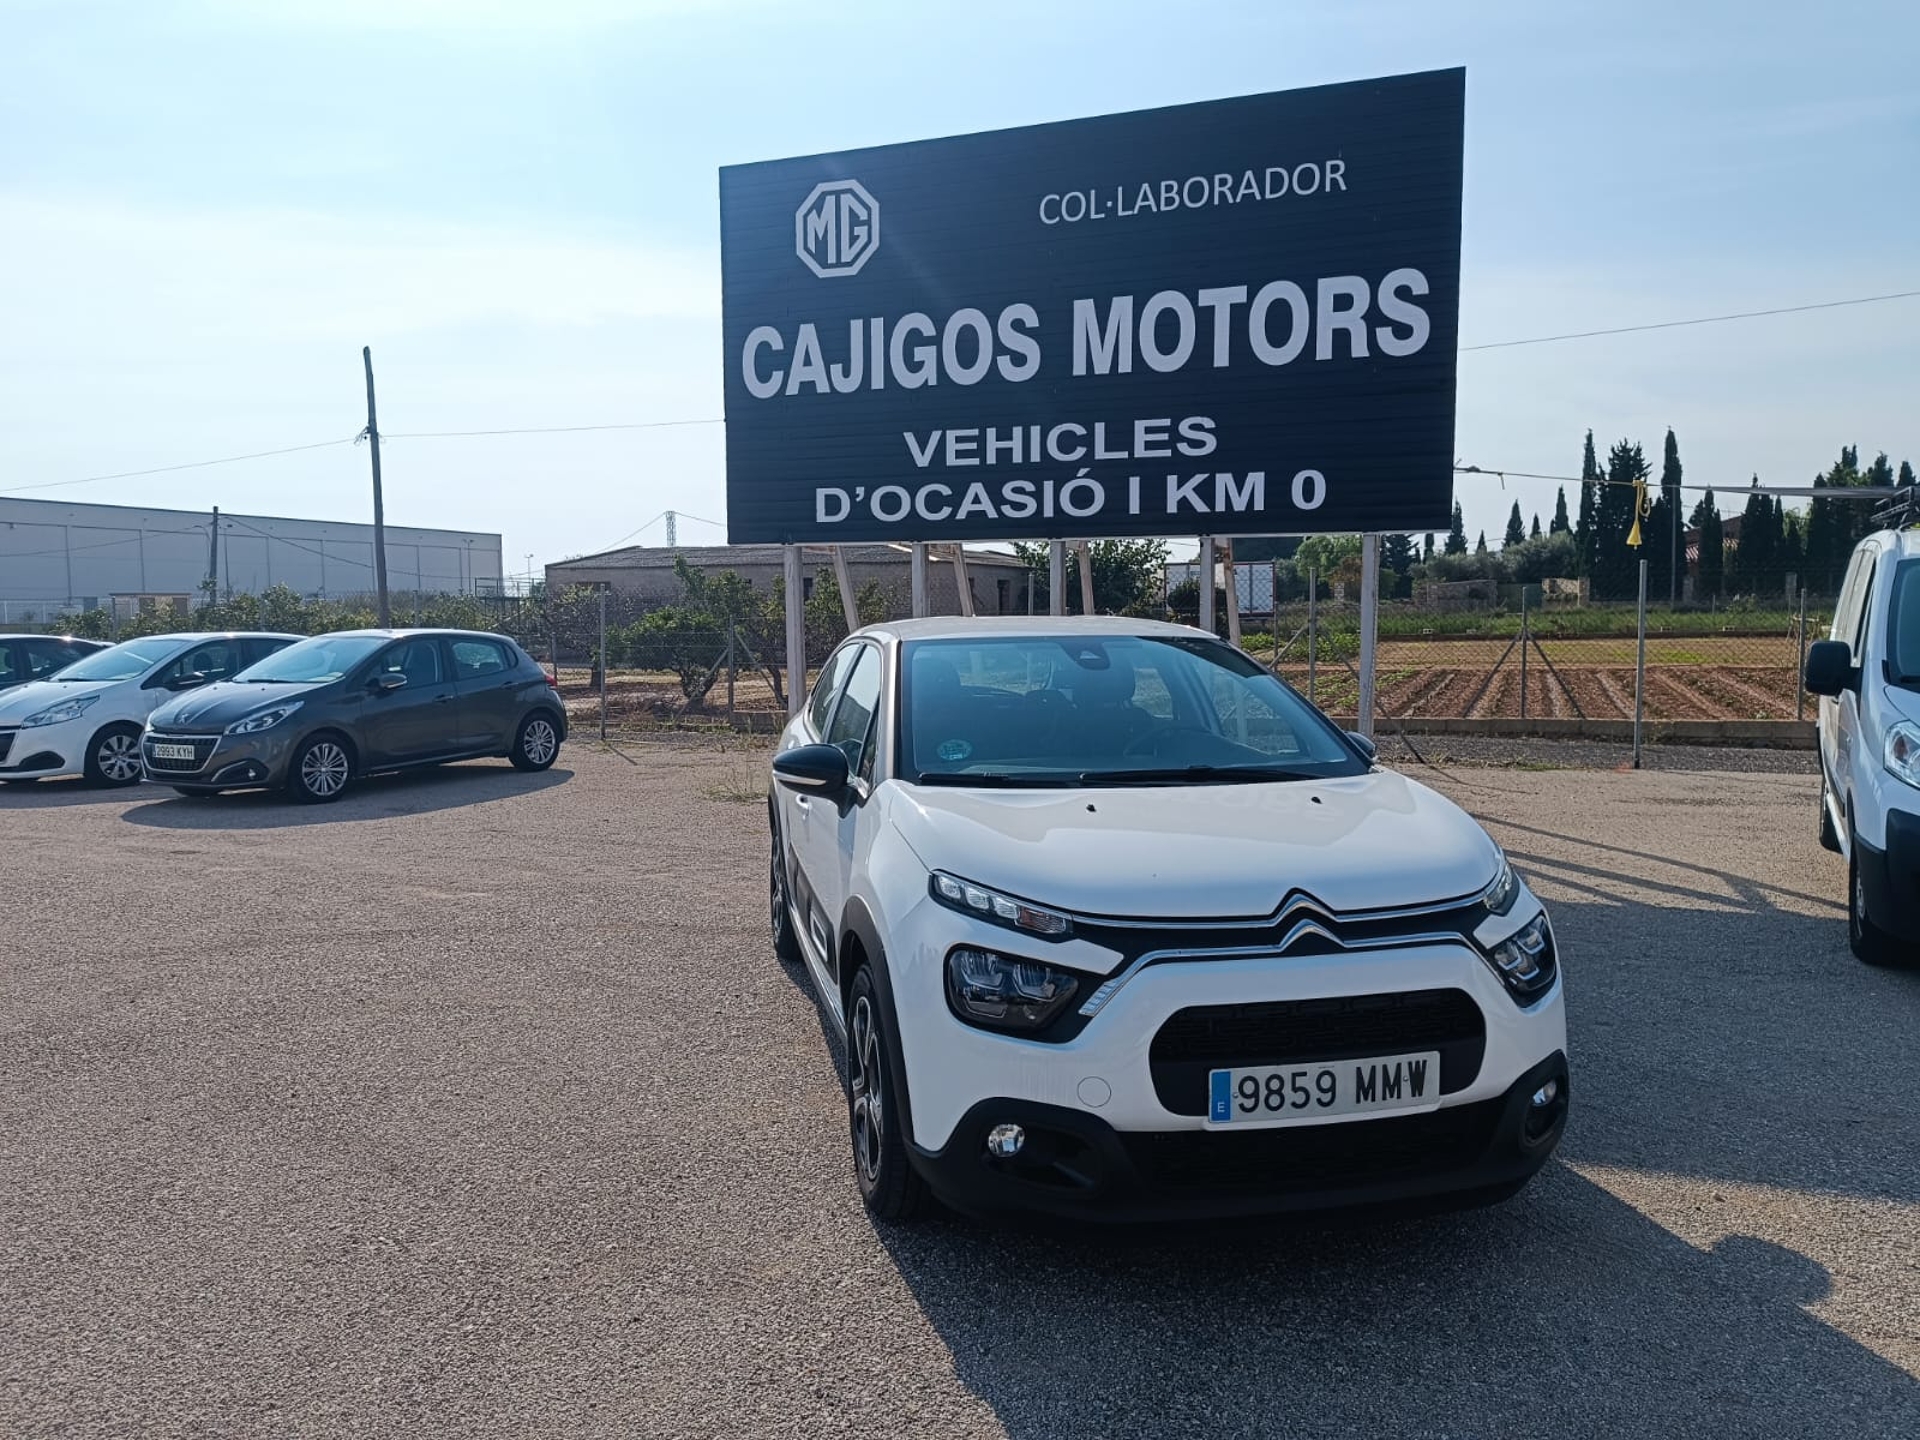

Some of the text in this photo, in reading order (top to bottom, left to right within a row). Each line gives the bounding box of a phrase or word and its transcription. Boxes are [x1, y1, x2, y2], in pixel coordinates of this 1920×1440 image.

[804, 190, 872, 268] MG
[742, 267, 1431, 399] CAJIGOS MOTORS
[903, 416, 1218, 468] VEHICLES
[1128, 476, 1141, 515] I
[1166, 471, 1266, 514] KM
[177, 746, 193, 758] KYH
[1217, 1101, 1225, 1113] E
[1238, 1059, 1428, 1114] 9859 MMW
